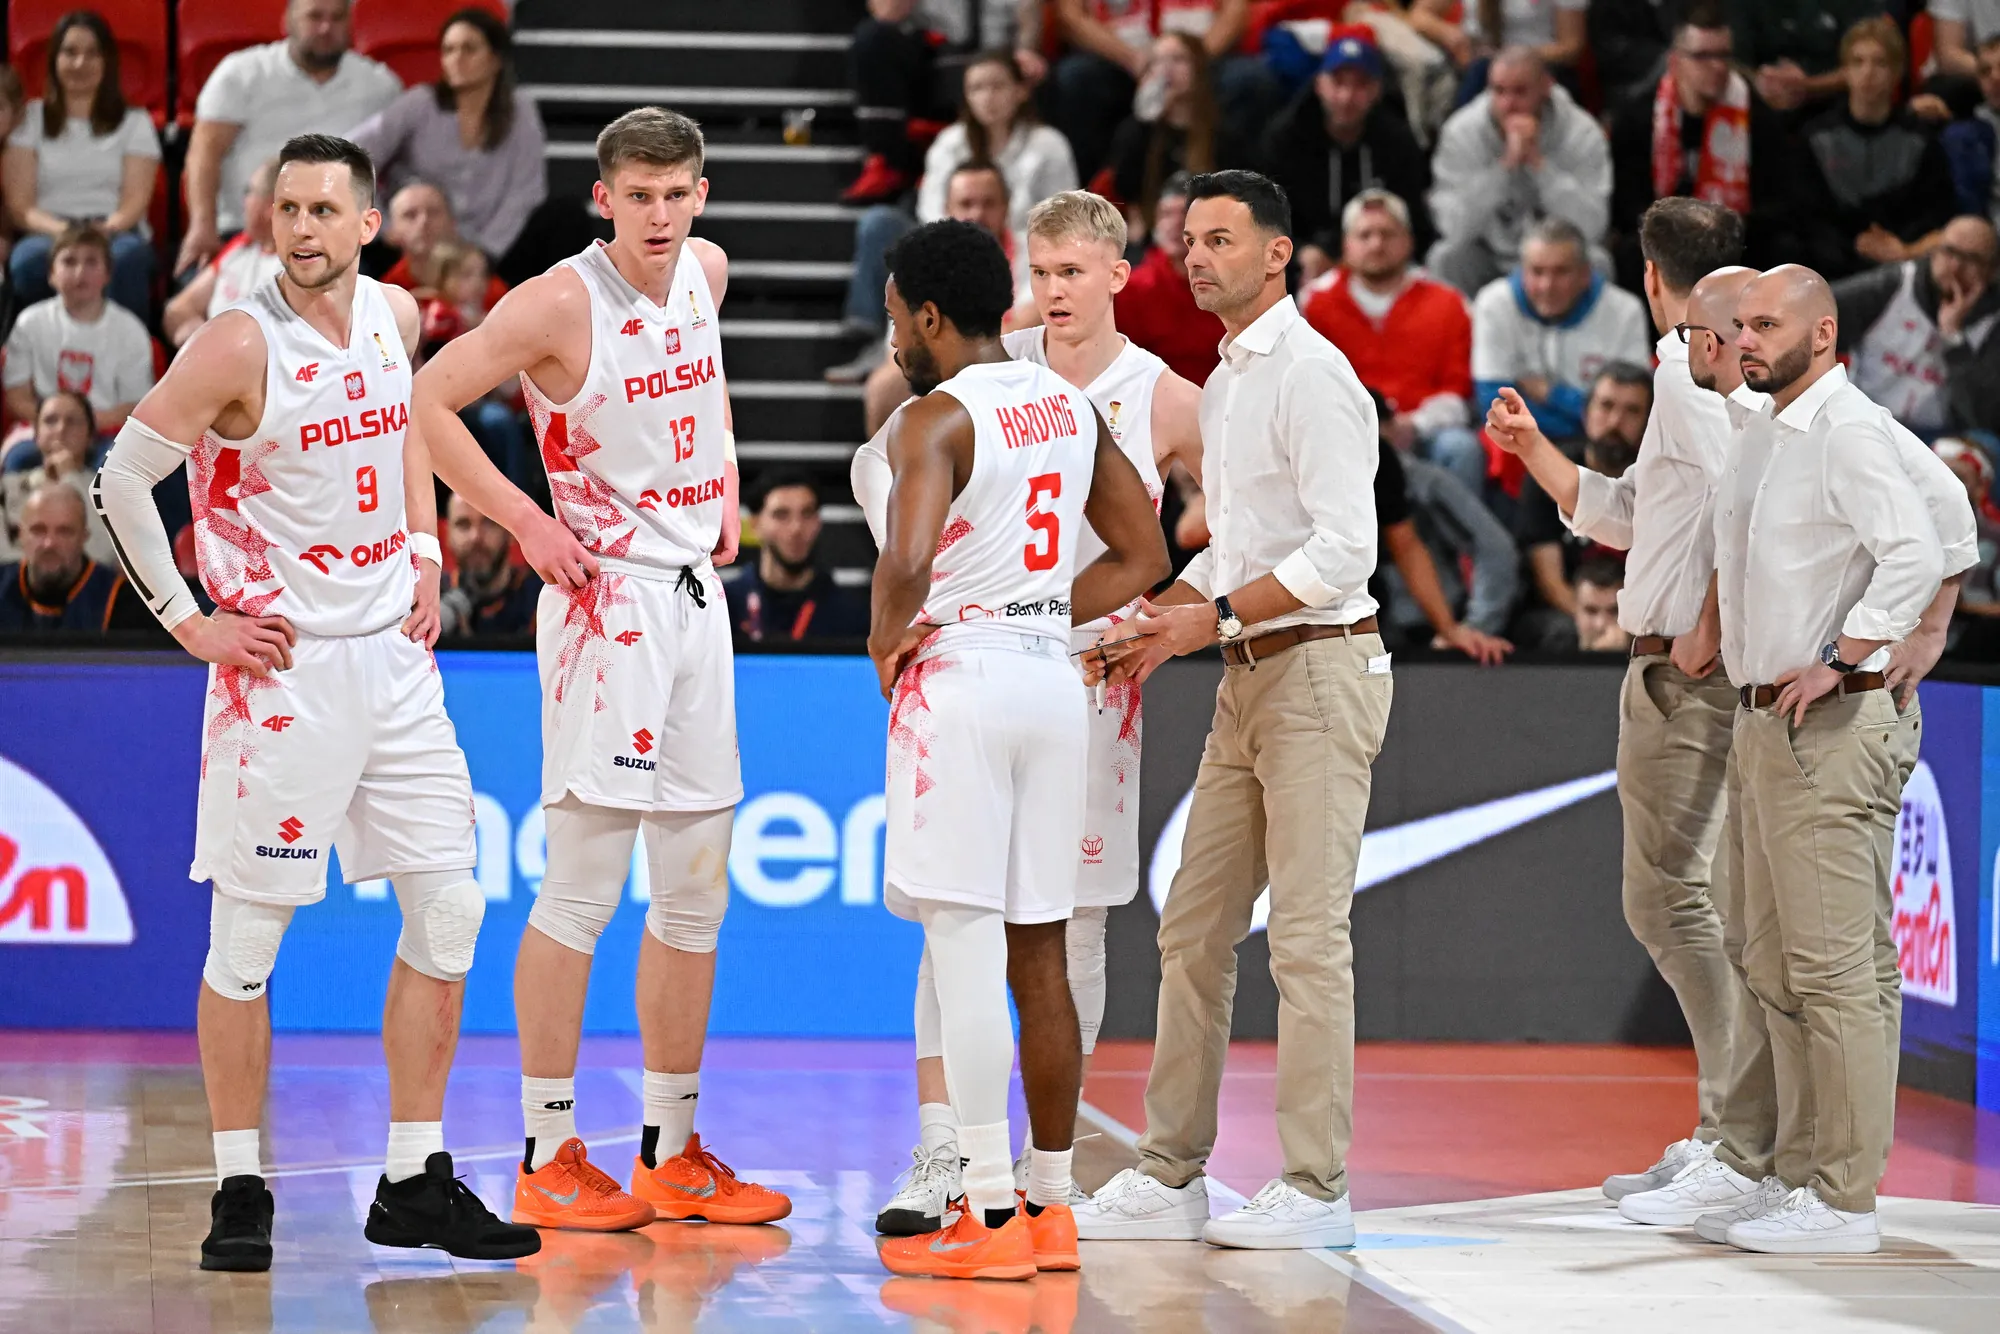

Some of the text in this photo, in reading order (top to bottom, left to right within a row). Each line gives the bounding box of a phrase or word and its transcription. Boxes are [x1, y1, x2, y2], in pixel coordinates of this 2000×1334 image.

[620, 318, 645, 336] 4F
[295, 362, 320, 382] 4F
[624, 355, 717, 404] POLSKA
[300, 402, 409, 452] POLSKA
[995, 393, 1078, 449] HARDING
[669, 415, 696, 464] 13
[356, 465, 379, 514] 9
[666, 476, 725, 508] ORLEN
[1024, 472, 1062, 572] 5
[1006, 600, 1046, 616] Bank
[614, 630, 643, 647] 4F
[261, 714, 295, 732] 4F
[613, 755, 657, 772] SUZUK
[255, 845, 318, 860] SUZUKI
